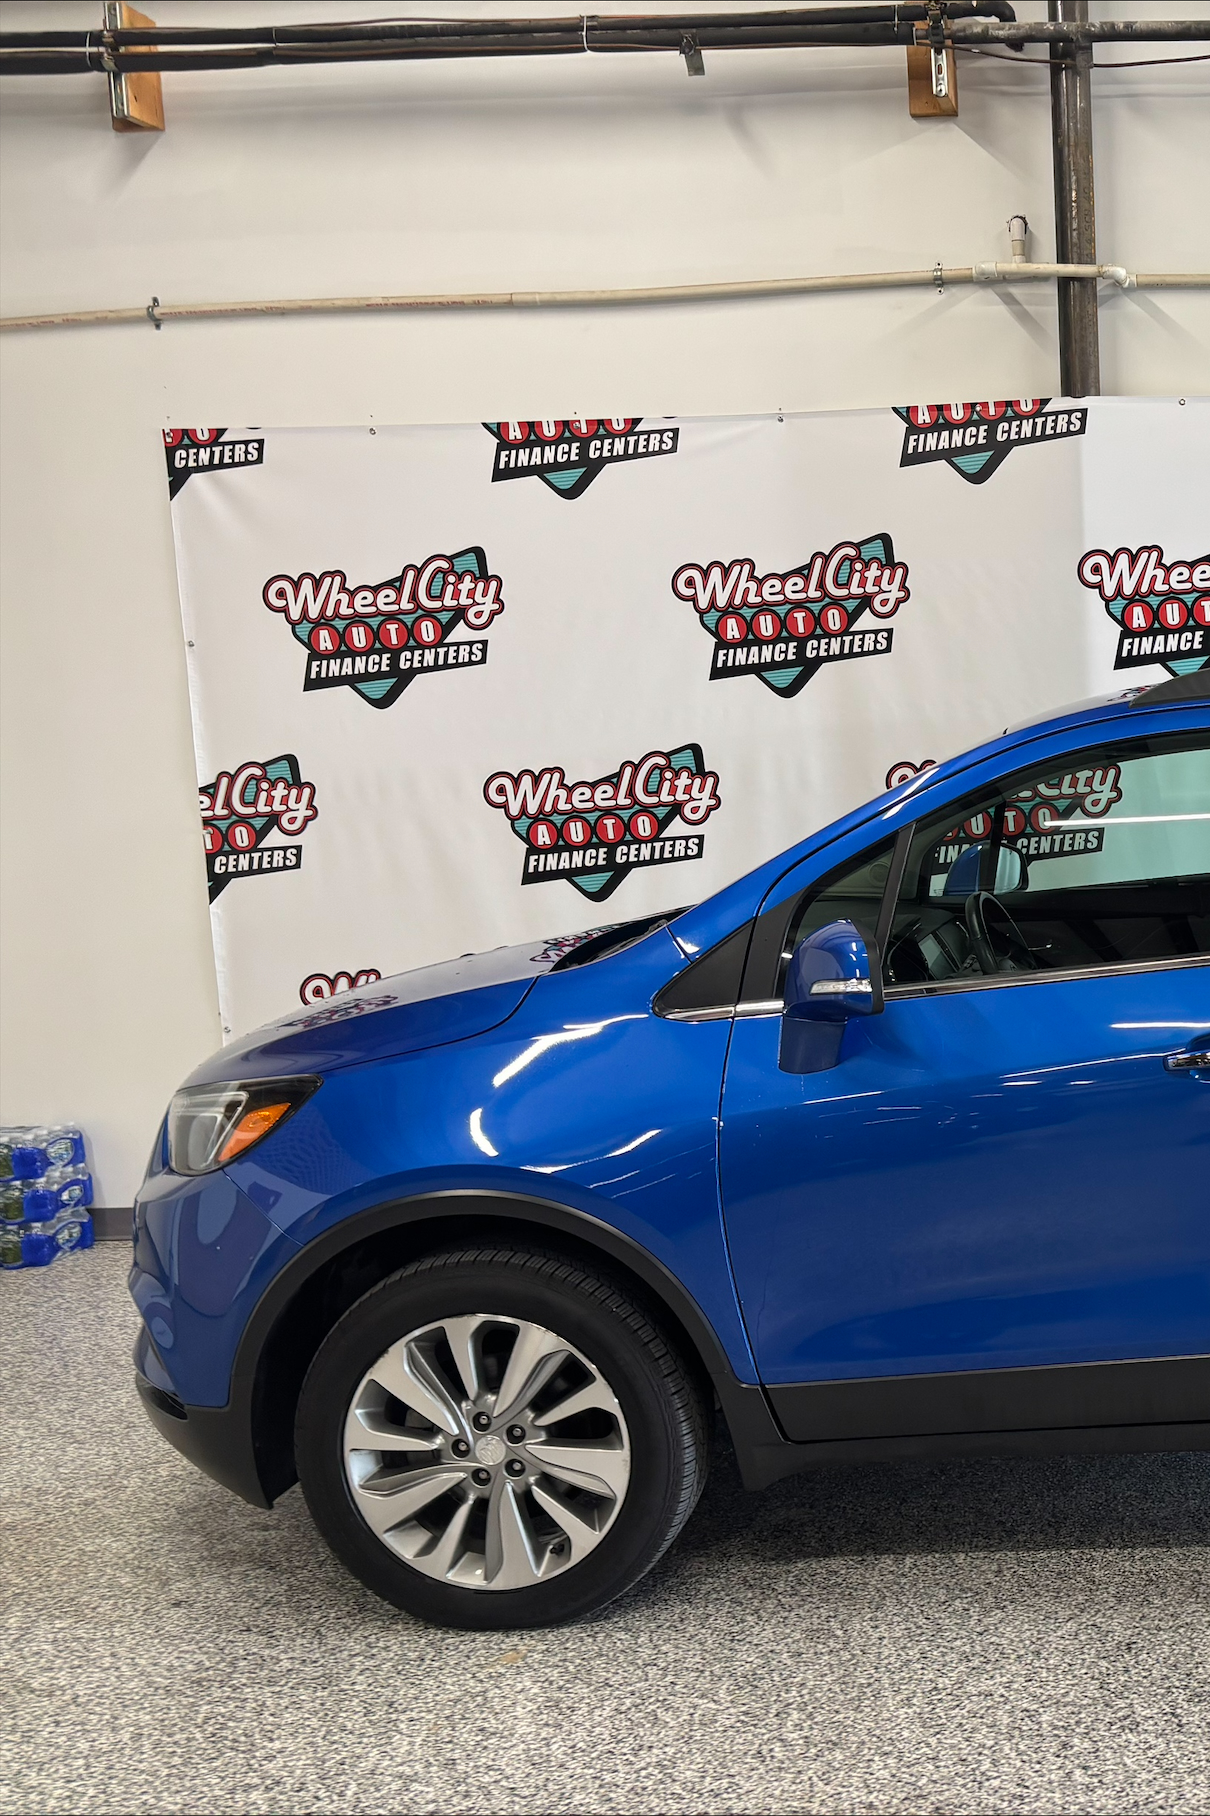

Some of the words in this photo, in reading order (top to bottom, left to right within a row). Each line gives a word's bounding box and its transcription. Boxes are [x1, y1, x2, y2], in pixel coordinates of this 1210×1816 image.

[499, 442, 580, 470] FINANCE
[588, 431, 674, 459] CENTERS
[907, 425, 989, 454] FINANCE
[996, 412, 1082, 442] CENTERS
[174, 442, 259, 468] CENTERS
[266, 569, 415, 622] Wheel
[418, 558, 501, 627] City
[675, 556, 823, 611] Wheel
[825, 545, 907, 615] City
[318, 620, 435, 650] AUTO
[726, 608, 842, 640] AUTO
[310, 653, 391, 679] FINANCE
[399, 643, 483, 669] CENTERS
[716, 642, 798, 668] FINANCE
[806, 632, 888, 658] CENTERS
[1121, 630, 1203, 657] FINANCE
[231, 765, 315, 832] City
[487, 764, 633, 818] Wheel
[634, 755, 718, 822] City
[537, 815, 652, 845] AUTO
[1017, 831, 1099, 855] CENTERS
[214, 848, 298, 874] CENTERS
[527, 847, 608, 873] FINANCE
[615, 837, 699, 864] CENTERS
